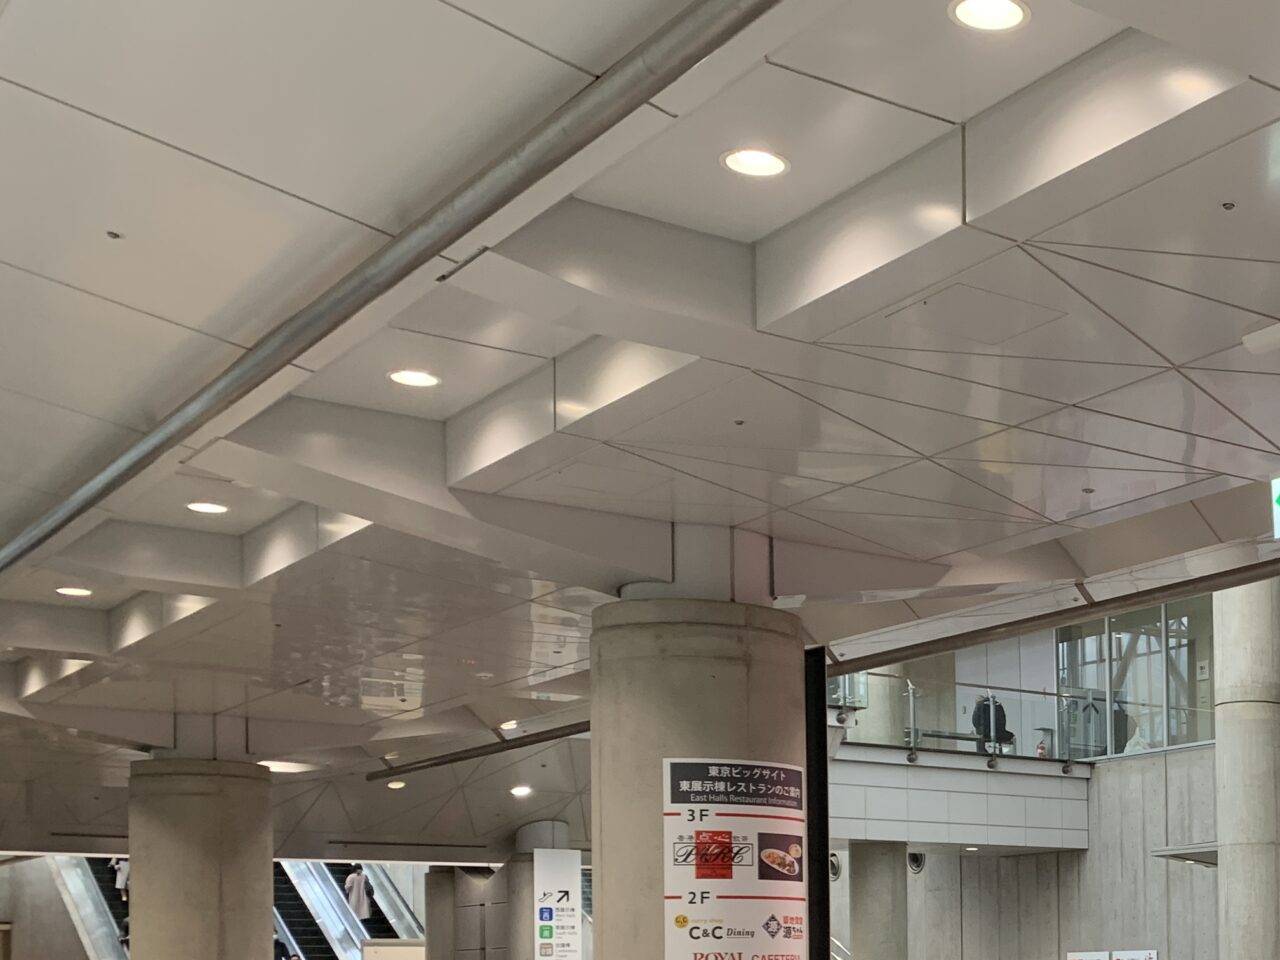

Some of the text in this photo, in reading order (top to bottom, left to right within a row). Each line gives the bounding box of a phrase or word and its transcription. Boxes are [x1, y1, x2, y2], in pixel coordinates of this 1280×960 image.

[708, 765, 786, 781] 東京ビッグサイト
[690, 794, 707, 802] East
[709, 794, 727, 802] Halls
[689, 926, 755, 939] C&C Dining
